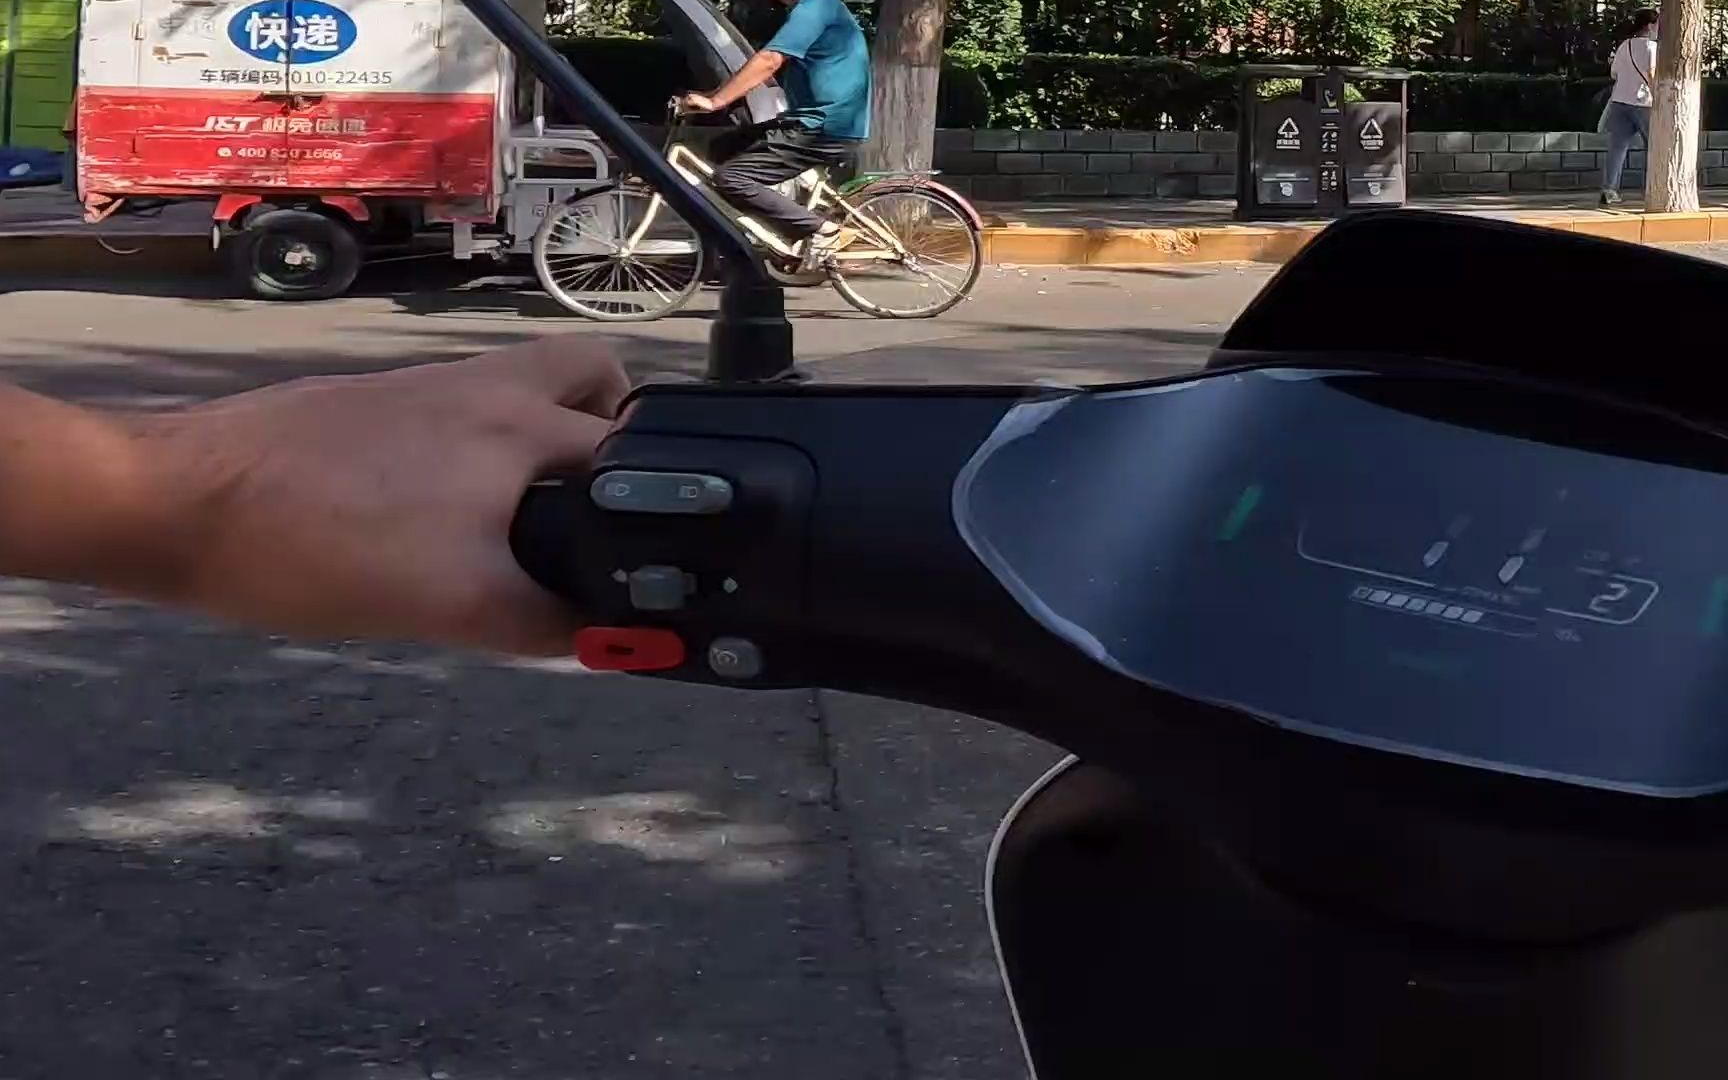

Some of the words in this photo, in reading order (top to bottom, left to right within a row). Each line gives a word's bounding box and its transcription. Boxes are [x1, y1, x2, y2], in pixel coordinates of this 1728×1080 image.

[244, 11, 340, 52] 快递
[291, 70, 392, 85] 010-22435
[1589, 582, 1628, 613] 2
